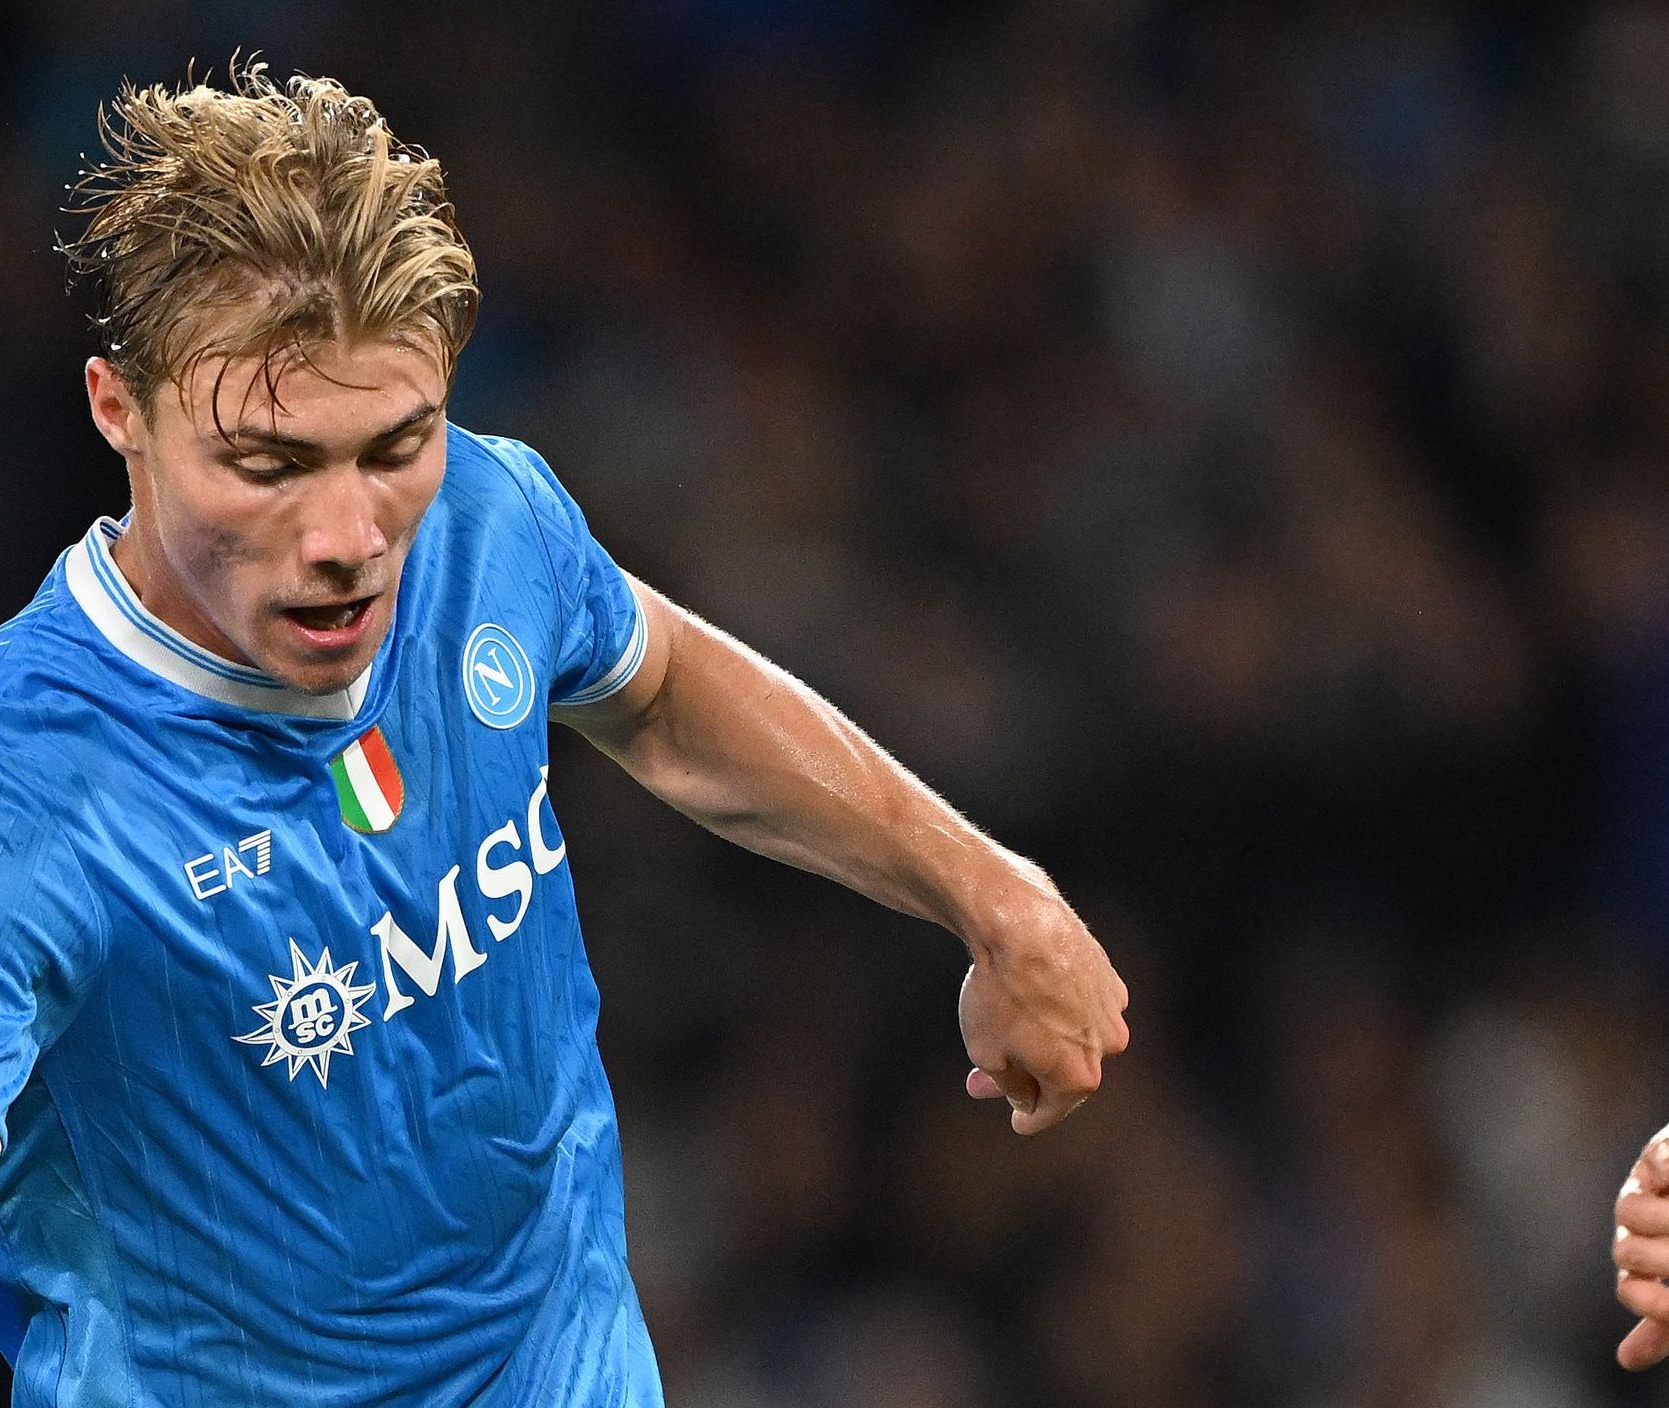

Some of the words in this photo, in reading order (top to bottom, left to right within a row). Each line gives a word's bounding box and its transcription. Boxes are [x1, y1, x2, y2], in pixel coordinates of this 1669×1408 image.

[474, 647, 514, 706] N
[183, 829, 272, 900] EA7
[370, 765, 566, 1022] MSC
